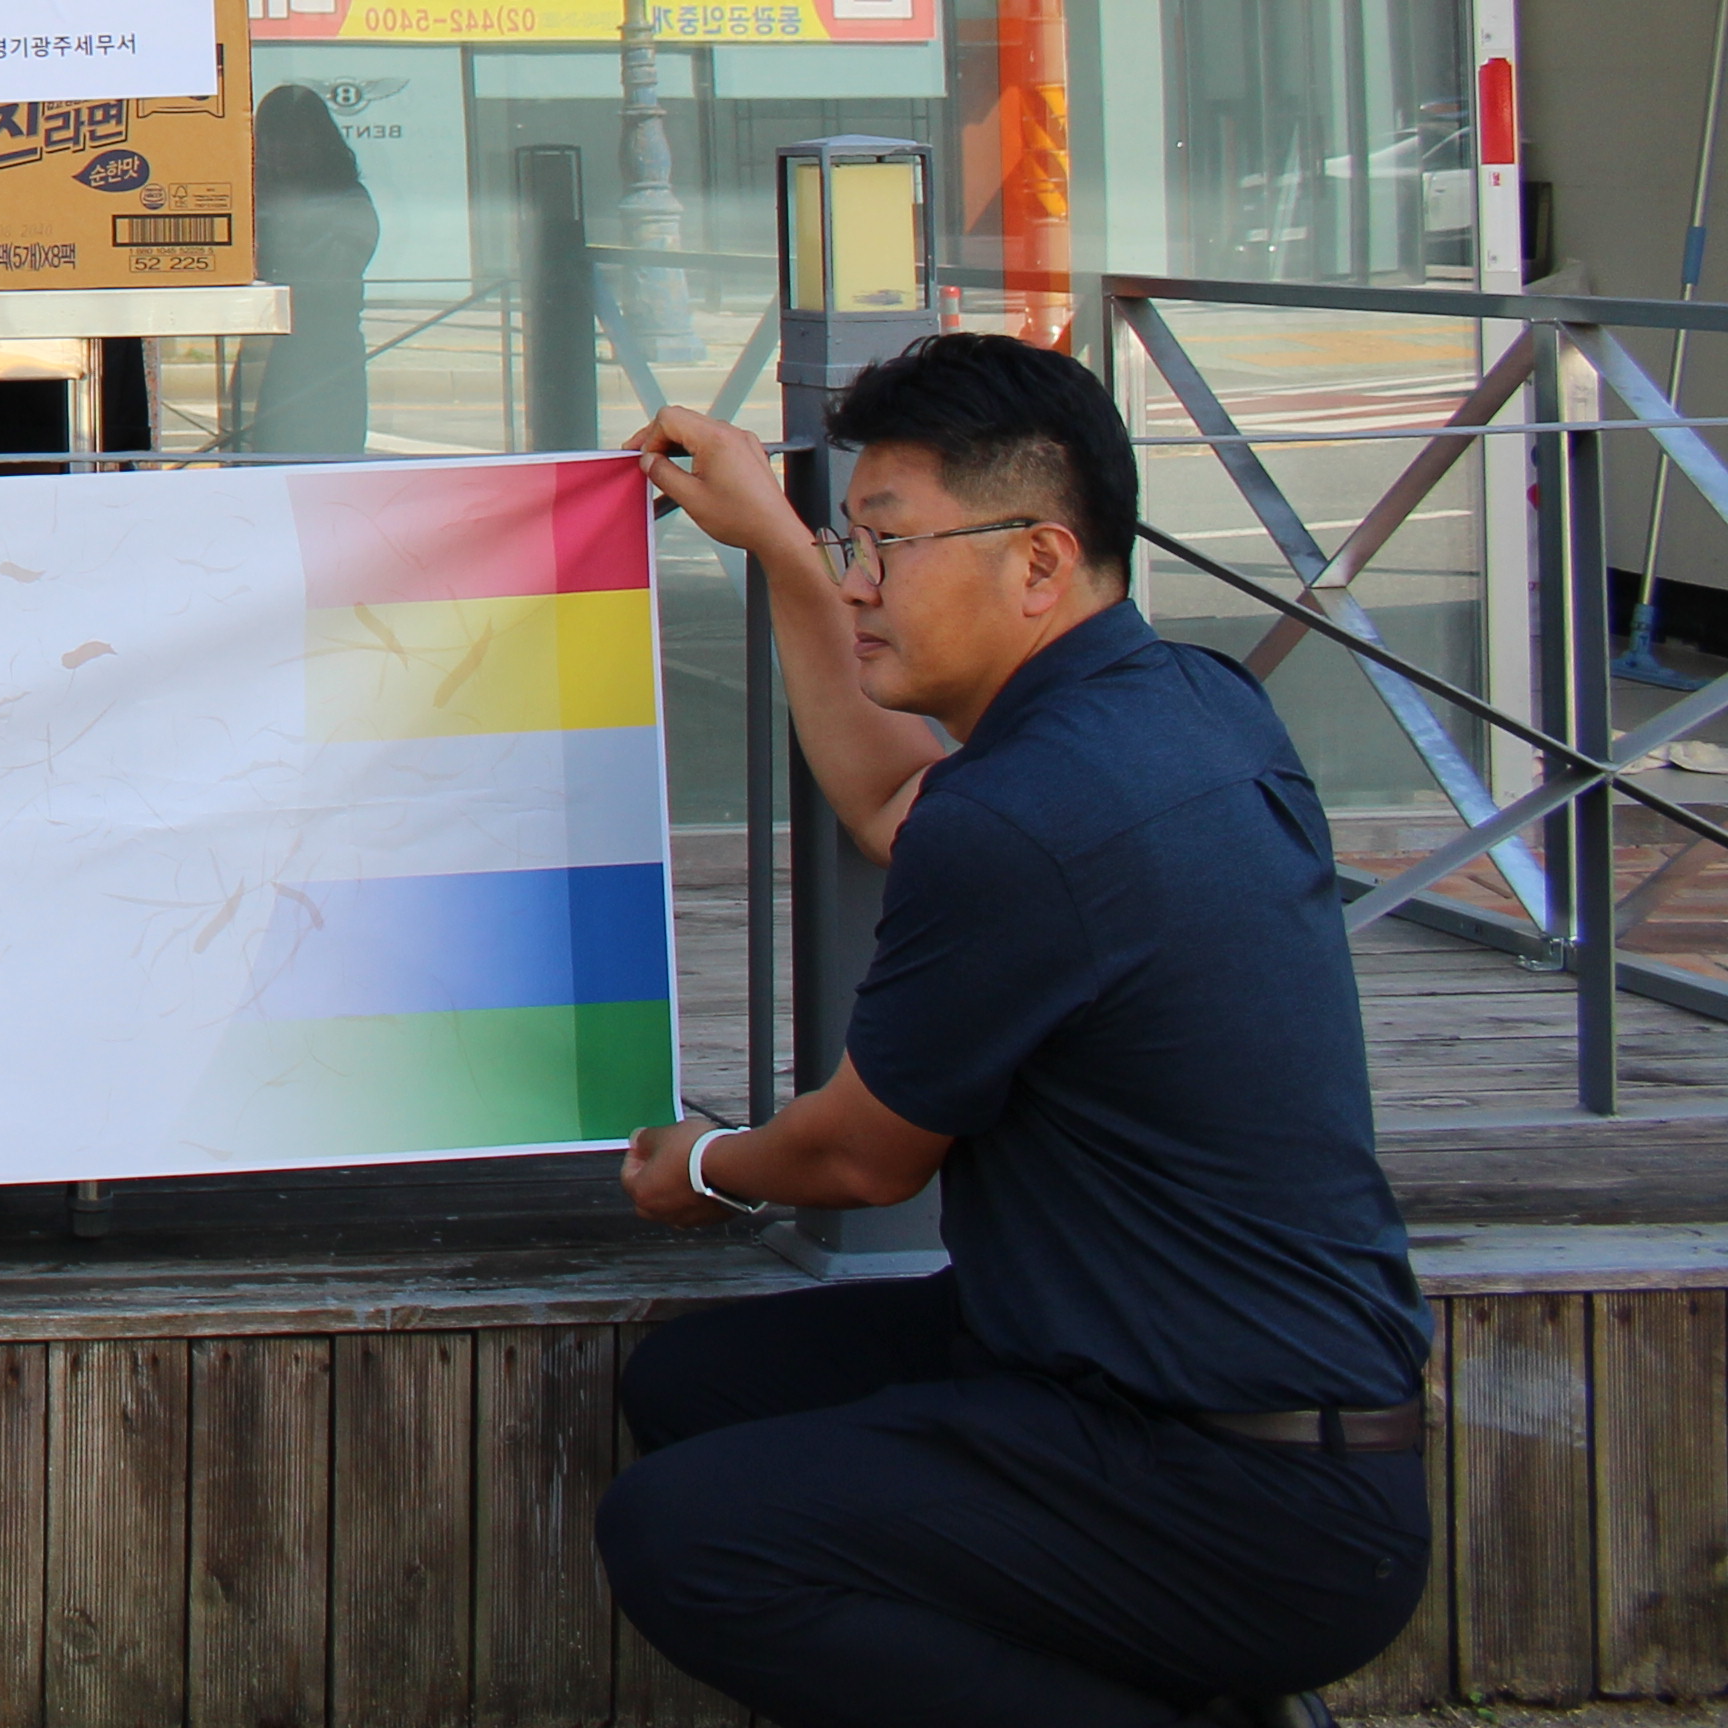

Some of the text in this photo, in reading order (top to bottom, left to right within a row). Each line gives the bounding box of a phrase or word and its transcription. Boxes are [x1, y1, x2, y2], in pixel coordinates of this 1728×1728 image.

[88, 156, 140, 187] 순한맛
[134, 257, 209, 271] 52 225
